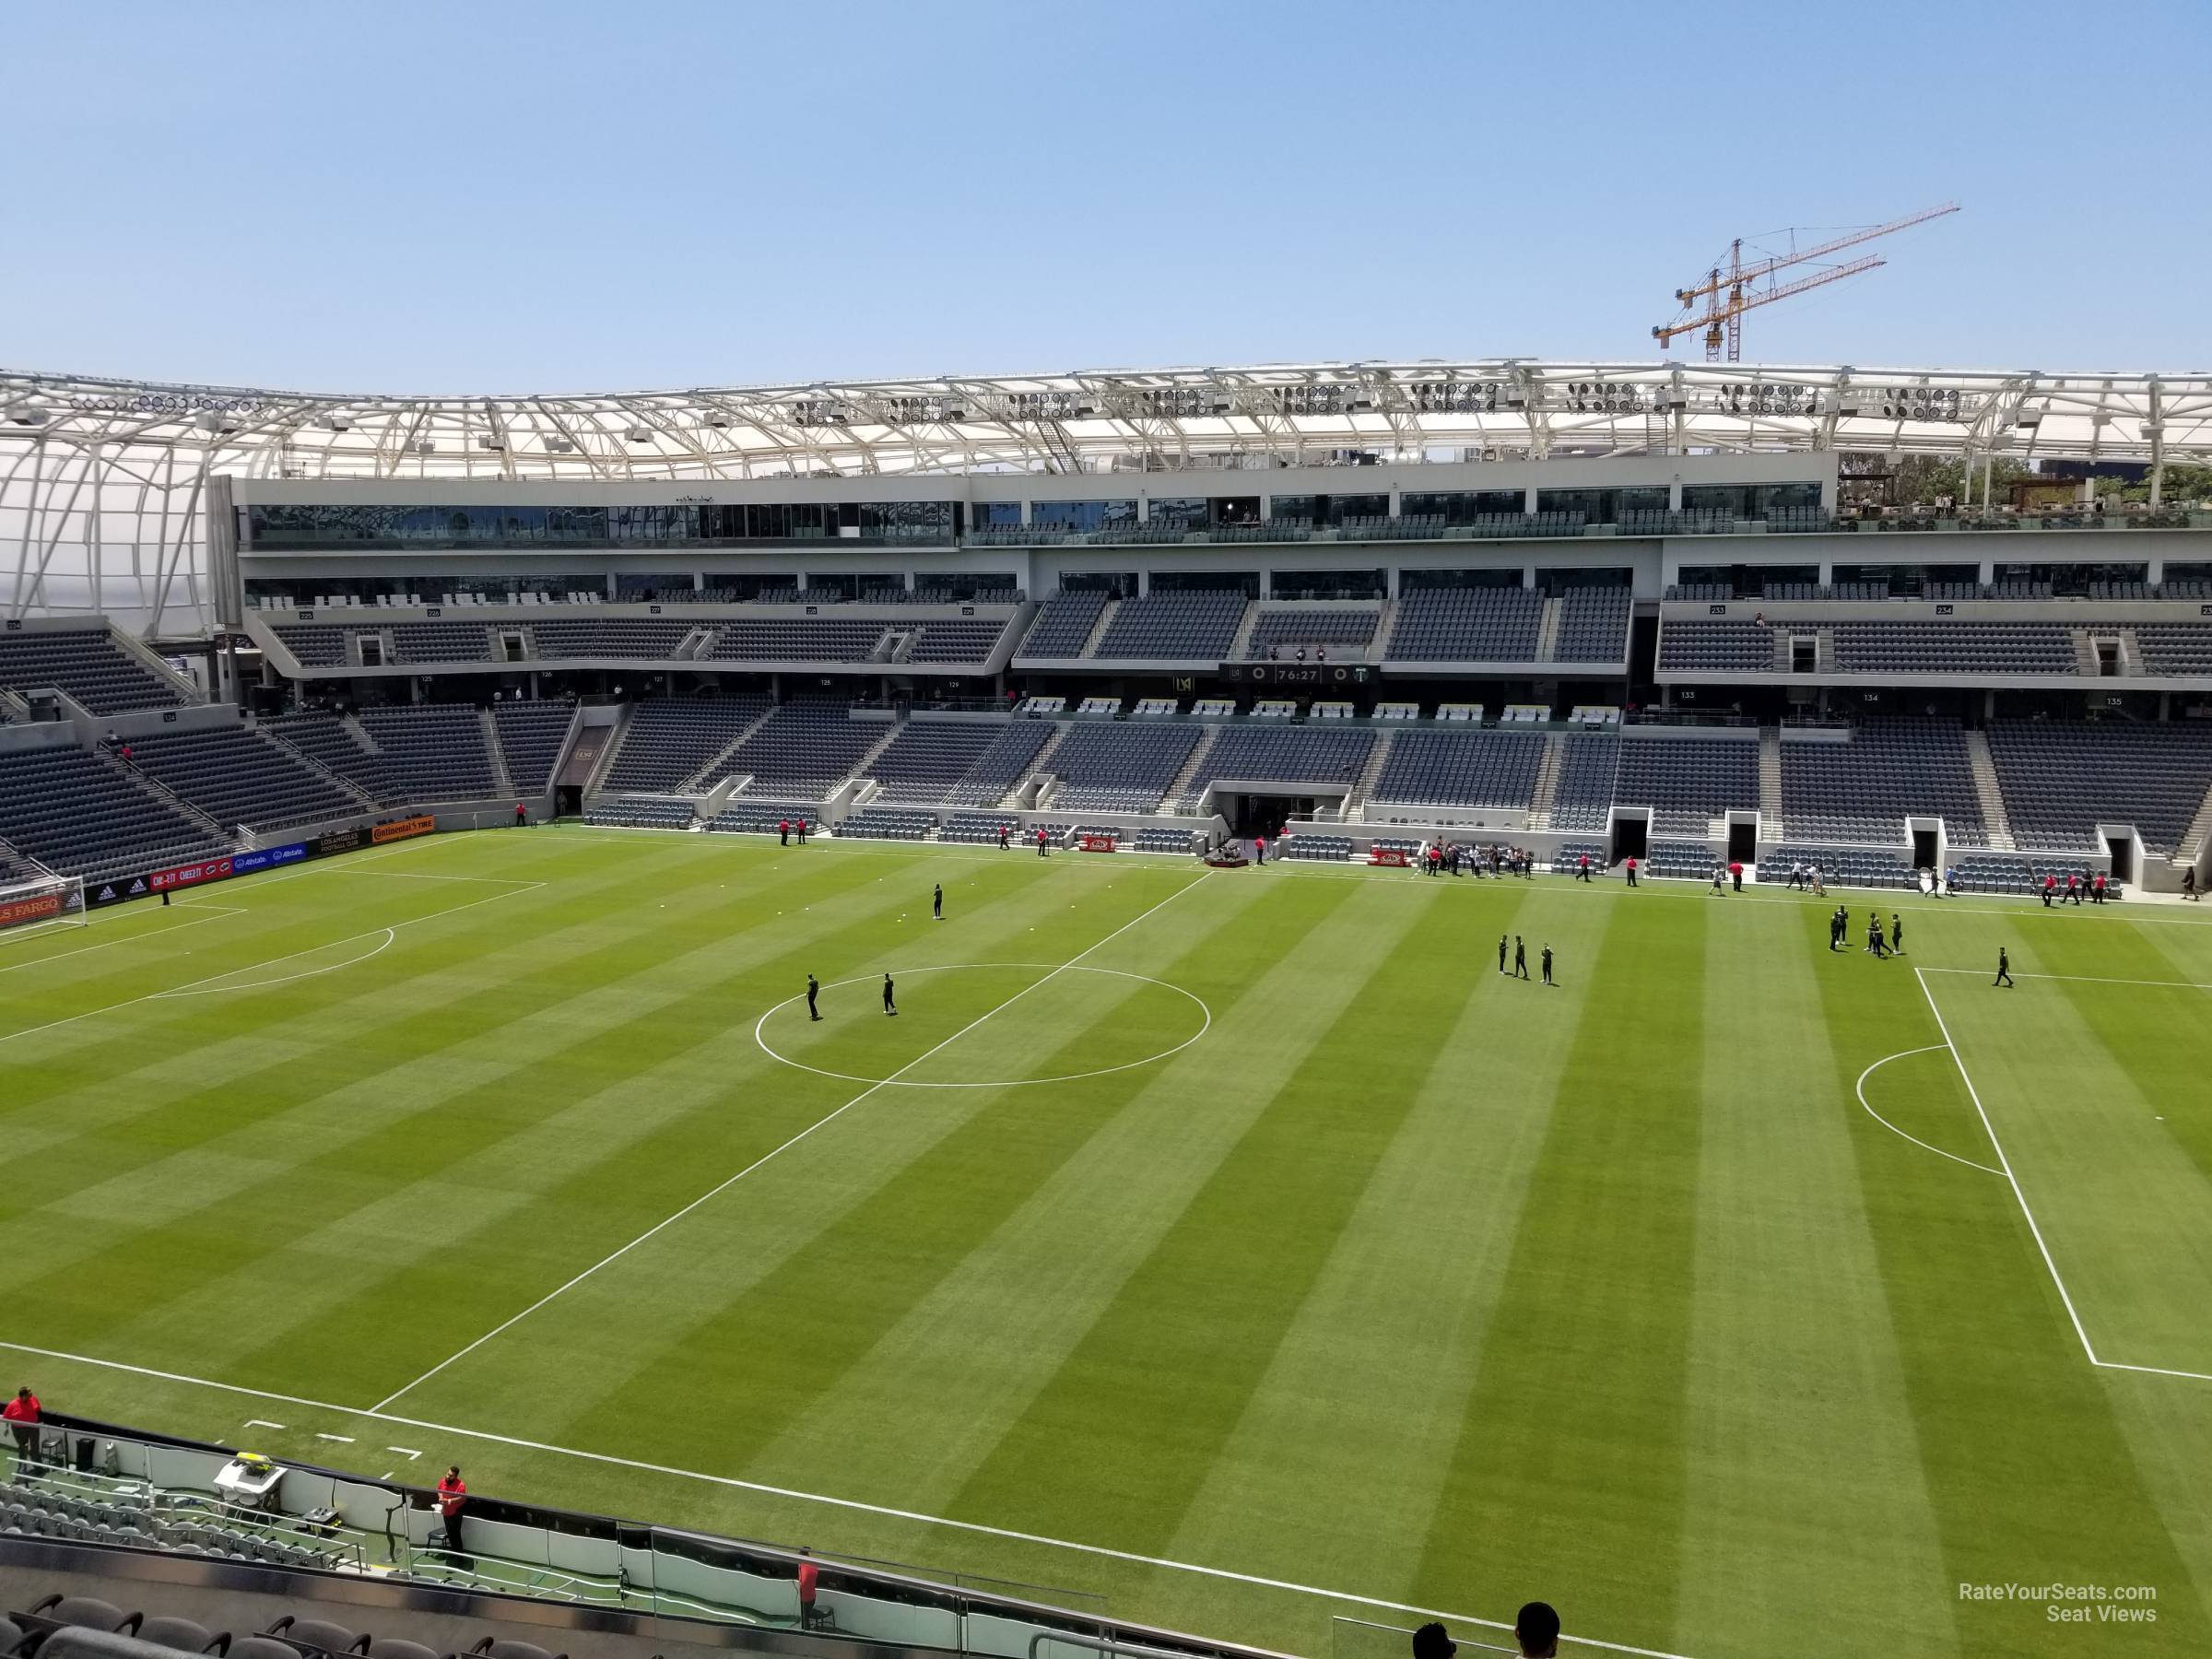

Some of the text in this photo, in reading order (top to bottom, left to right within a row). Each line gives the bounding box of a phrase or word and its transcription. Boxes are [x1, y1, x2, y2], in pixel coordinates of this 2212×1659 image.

[1253, 666, 1265, 679] 0
[1278, 670, 1317, 680] 76:27
[1335, 668, 1347, 680] 0
[164, 712, 175, 721] 124
[374, 819, 432, 841] Continental TIRE
[15, 899, 58, 916] FARGO
